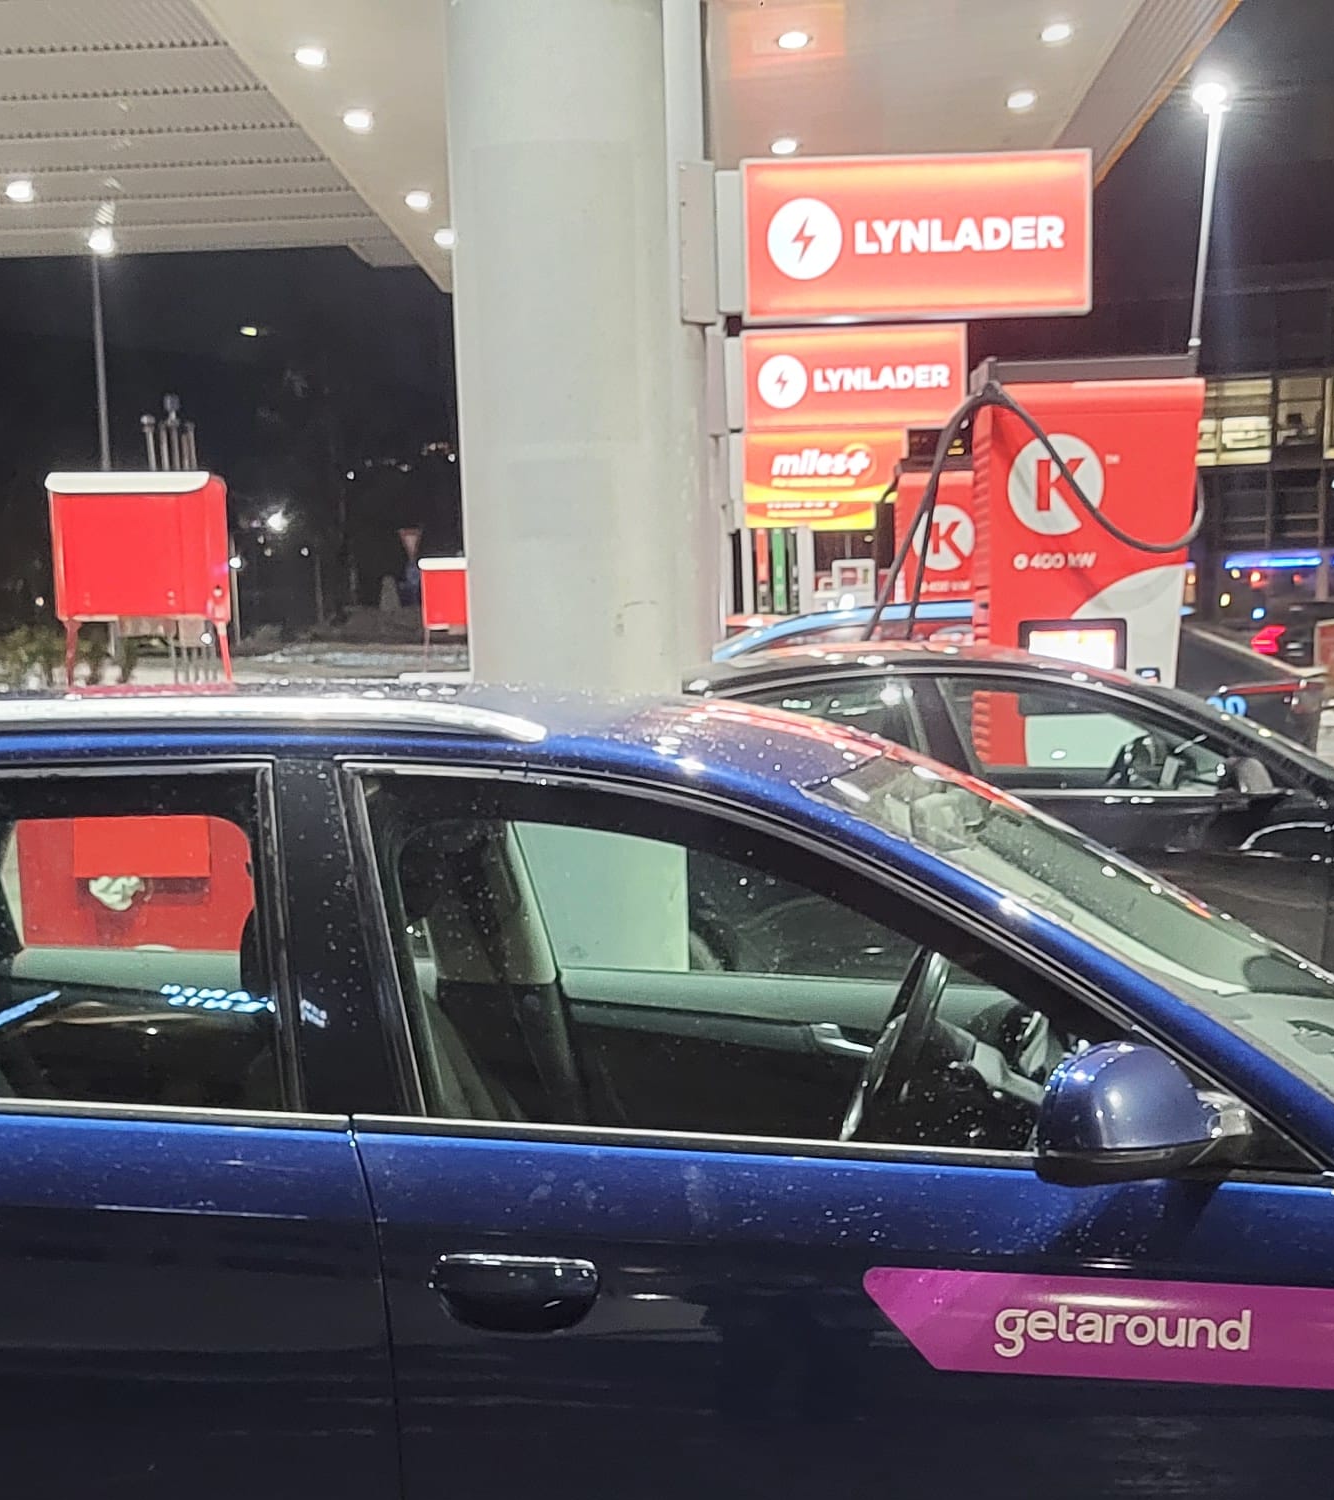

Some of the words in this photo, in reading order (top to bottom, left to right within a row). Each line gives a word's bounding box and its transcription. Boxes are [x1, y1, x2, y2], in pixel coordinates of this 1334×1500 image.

[854, 216, 1065, 255] LYNLADER
[813, 364, 950, 392] LYNLADER
[1029, 552, 1065, 569] 400
[992, 1304, 1252, 1358] getaround
